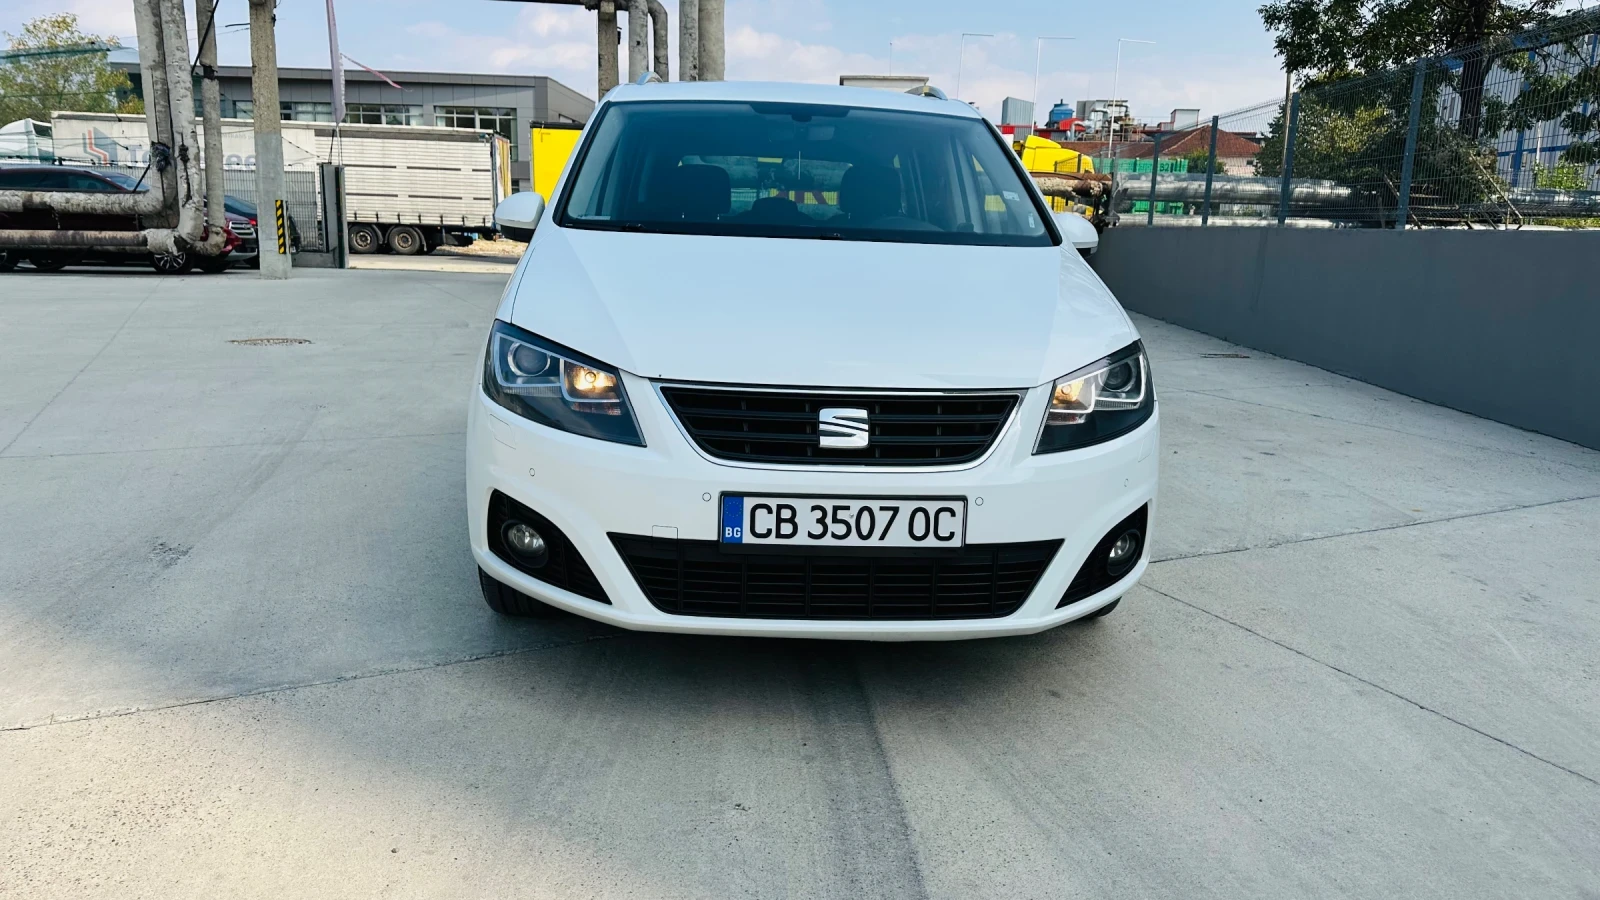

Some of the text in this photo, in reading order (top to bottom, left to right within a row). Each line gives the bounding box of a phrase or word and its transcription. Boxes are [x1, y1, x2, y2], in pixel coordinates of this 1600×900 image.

[725, 526, 742, 538] BG
[749, 503, 956, 542] CB 3507 OC
